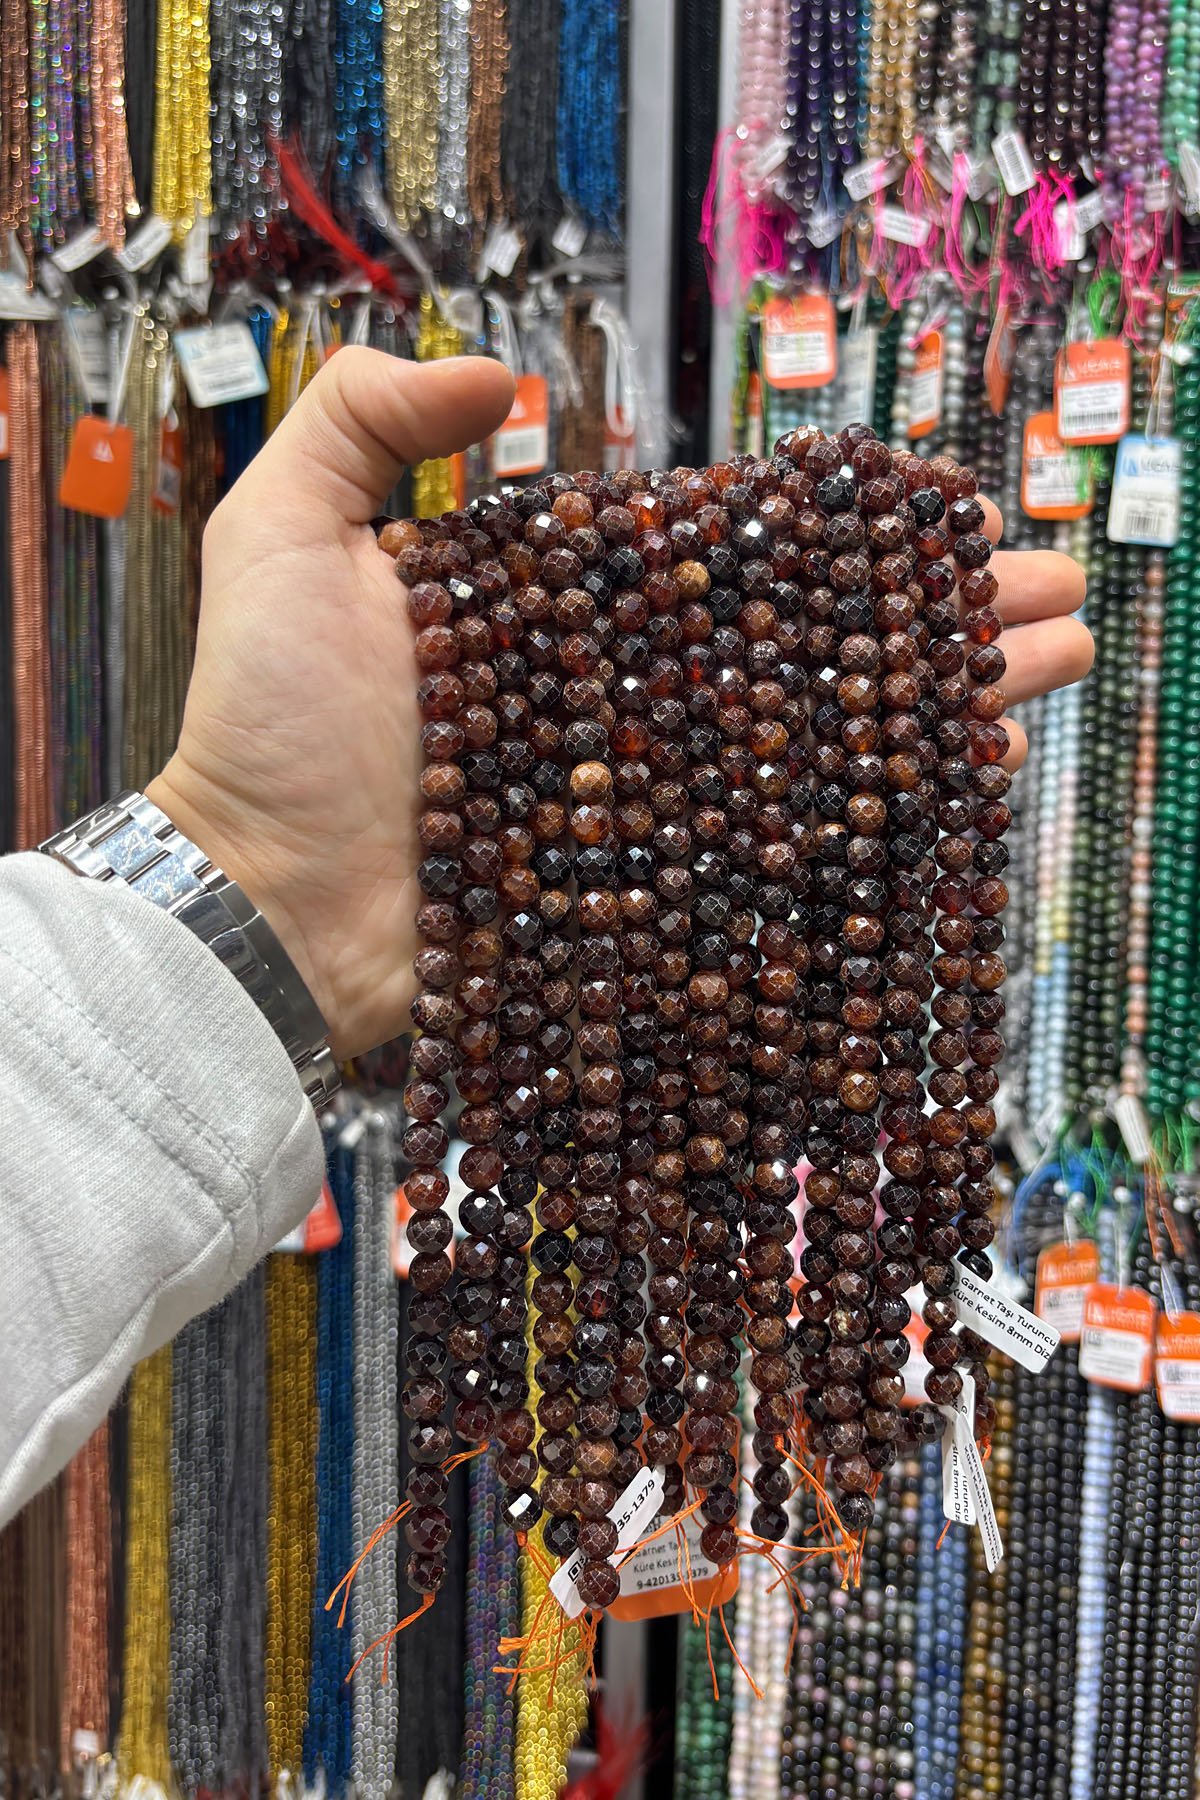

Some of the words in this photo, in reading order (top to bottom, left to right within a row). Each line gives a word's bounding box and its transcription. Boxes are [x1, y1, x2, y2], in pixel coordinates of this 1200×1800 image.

[961, 1277, 995, 1305] Garnet
[996, 1300, 1014, 1319] Taşı
[1017, 1314, 1057, 1347] Turuncu
[975, 1303, 1006, 1330] Kesim
[1006, 1325, 1034, 1349] 8mm
[616, 1479, 655, 1534] 35-1379
